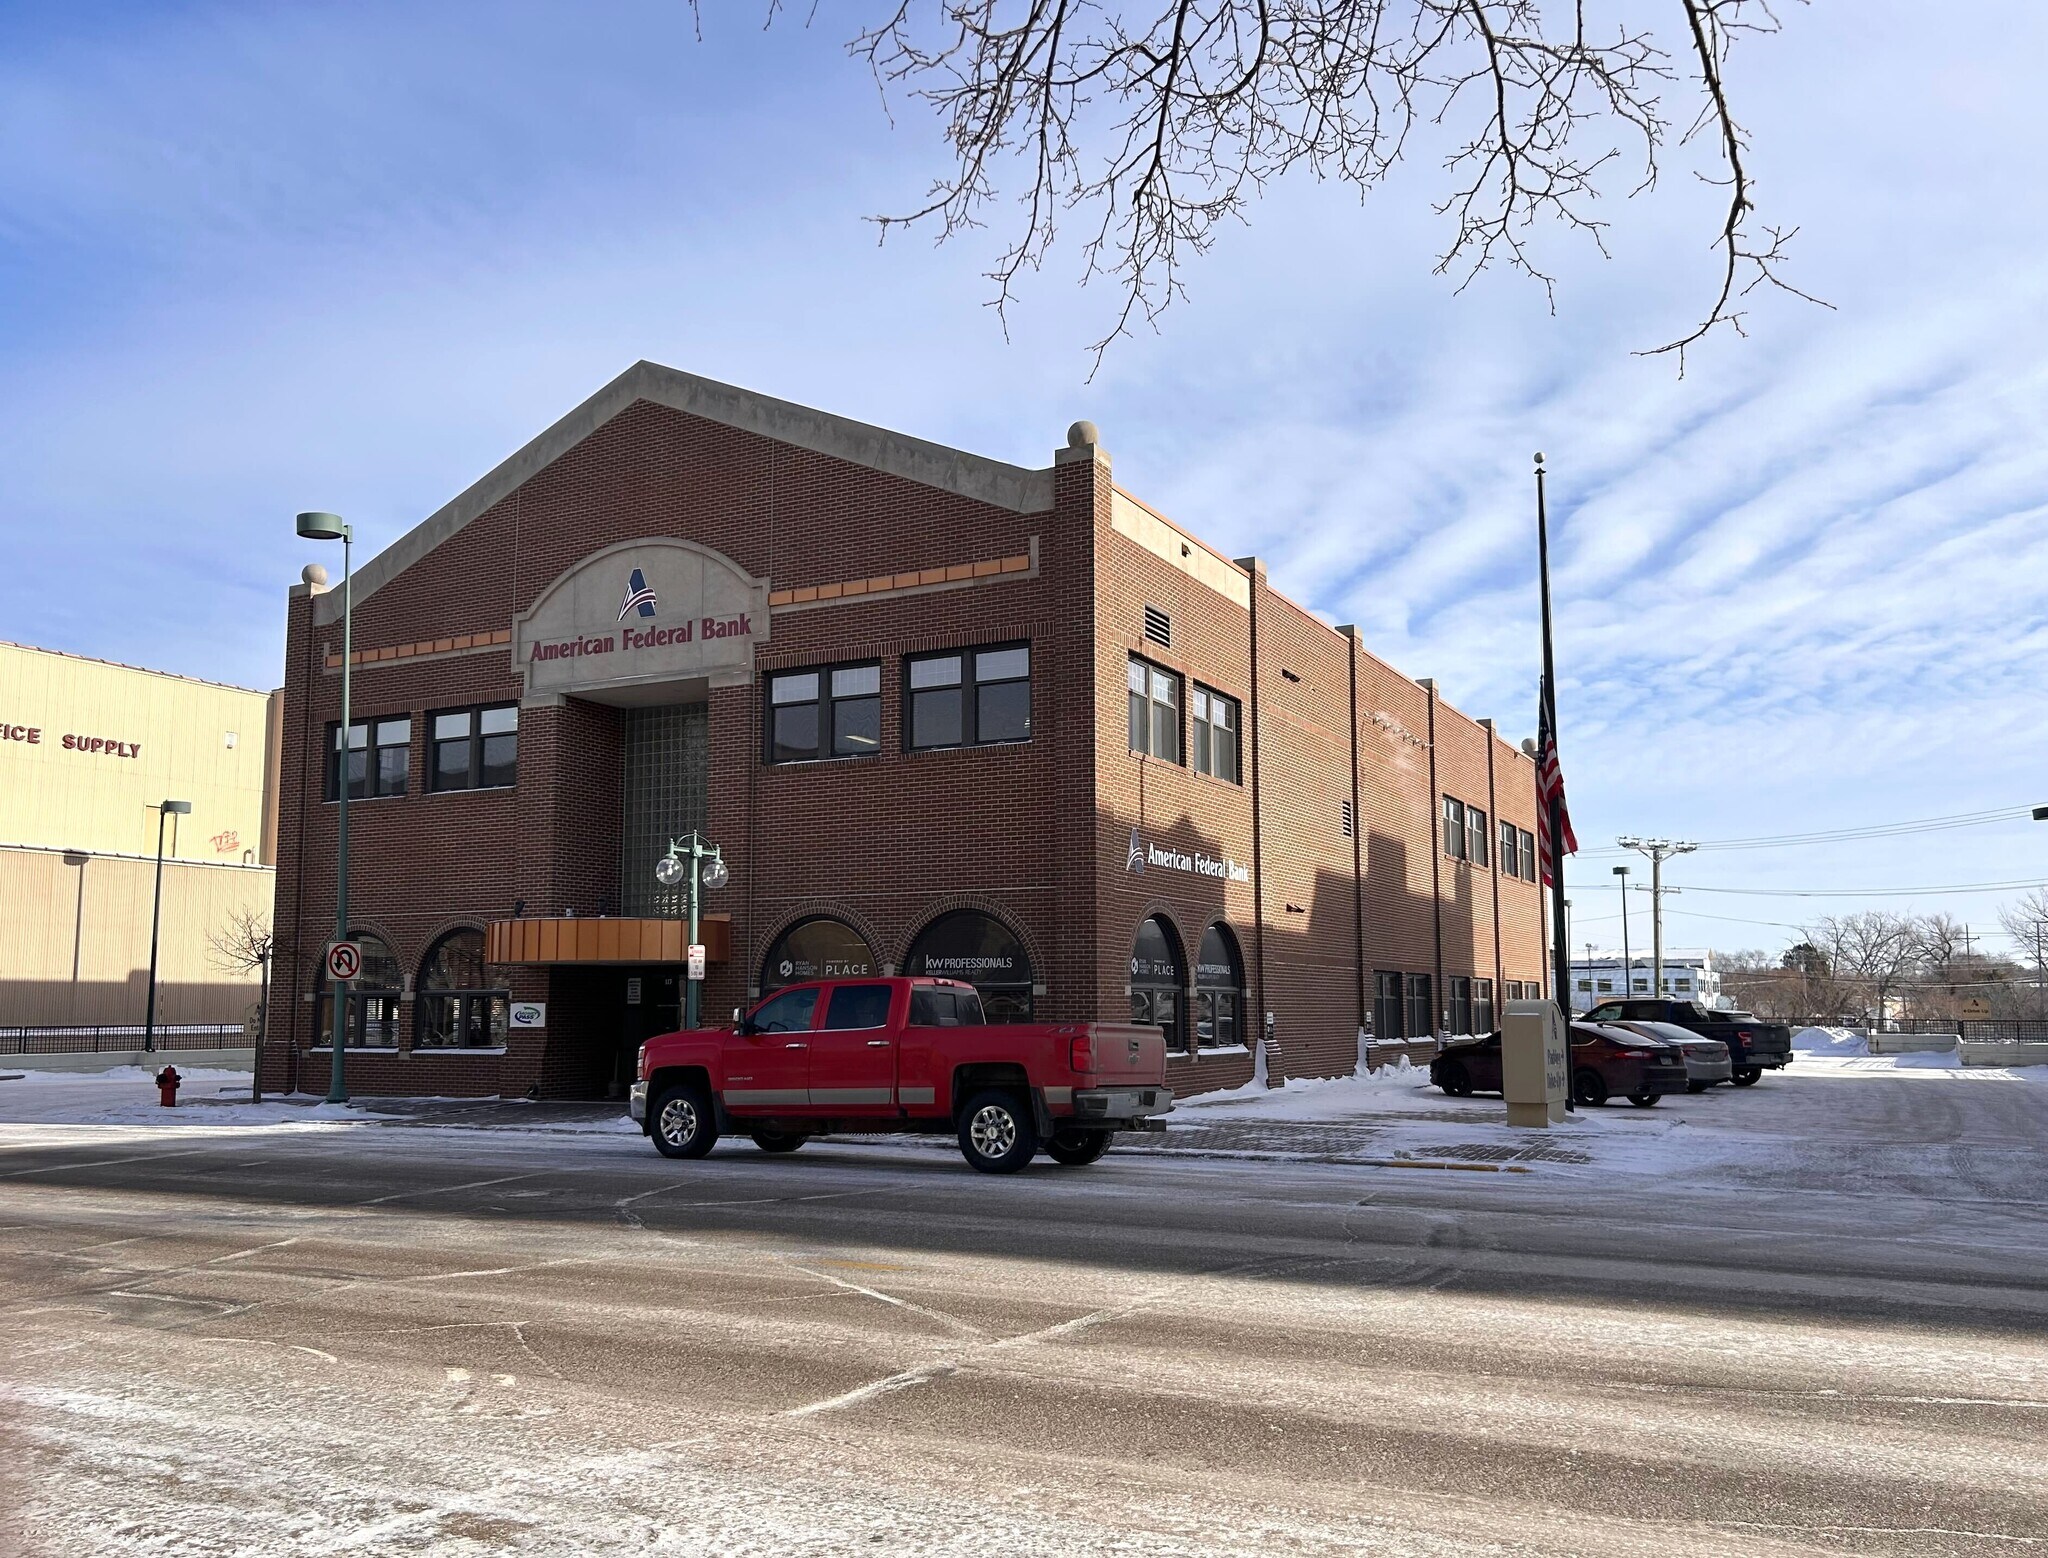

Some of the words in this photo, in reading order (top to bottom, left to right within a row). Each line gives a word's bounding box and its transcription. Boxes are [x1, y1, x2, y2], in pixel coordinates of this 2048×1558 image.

[530, 636, 615, 663] American
[623, 620, 693, 651] Federal
[701, 613, 752, 641] Bank
[62, 734, 141, 758] SUPPLY
[1148, 842, 1192, 872] American
[1195, 852, 1226, 878] Federal
[1228, 859, 1249, 882] Bank
[825, 964, 868, 975] PLACE
[944, 957, 1013, 969] PROFESSIONALS
[1153, 964, 1175, 976] PLACE
